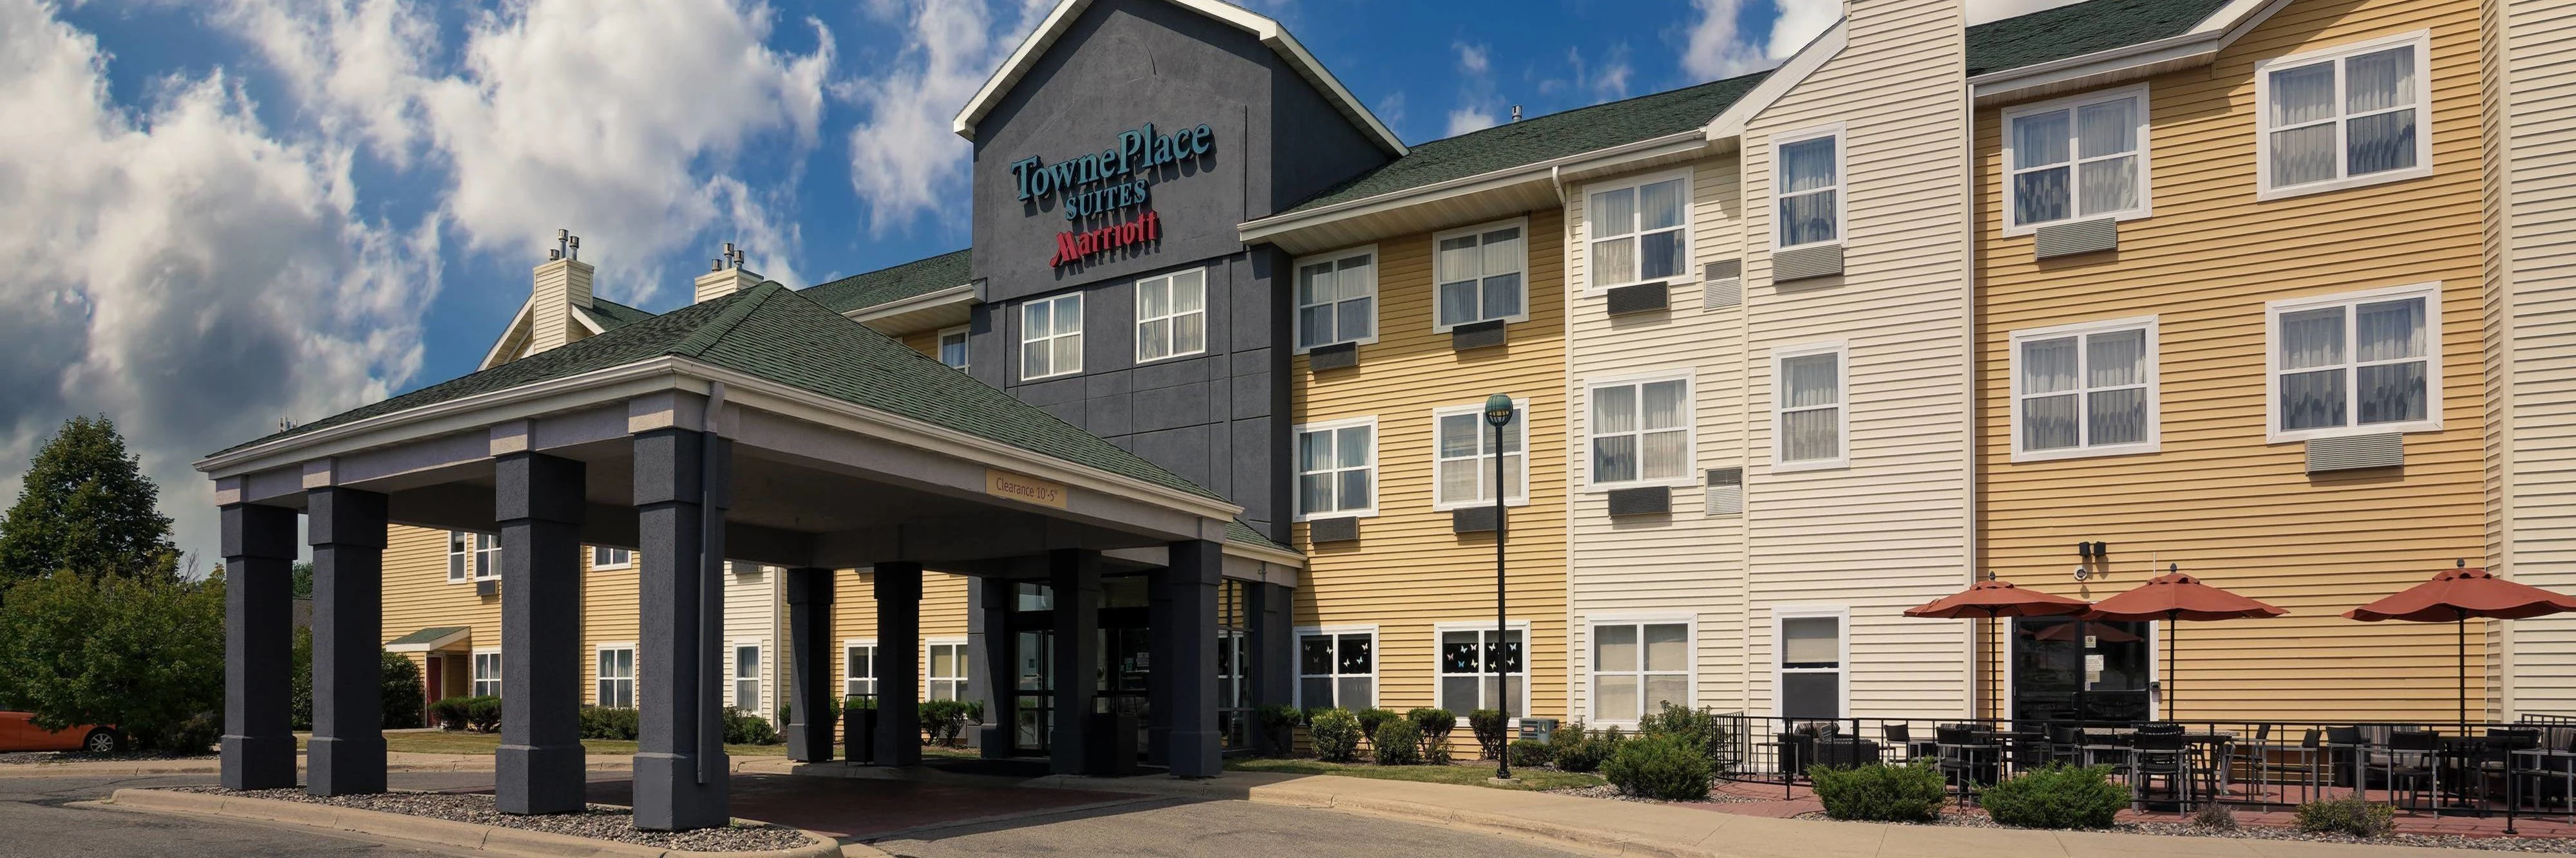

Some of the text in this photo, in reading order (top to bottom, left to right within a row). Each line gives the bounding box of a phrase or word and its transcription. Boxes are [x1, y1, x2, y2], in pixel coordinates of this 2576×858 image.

[1010, 121, 1211, 201] TownePlace
[1065, 178, 1148, 221] SUITES
[1049, 210, 1159, 268] Marriott
[996, 477, 1034, 497] Clearance
